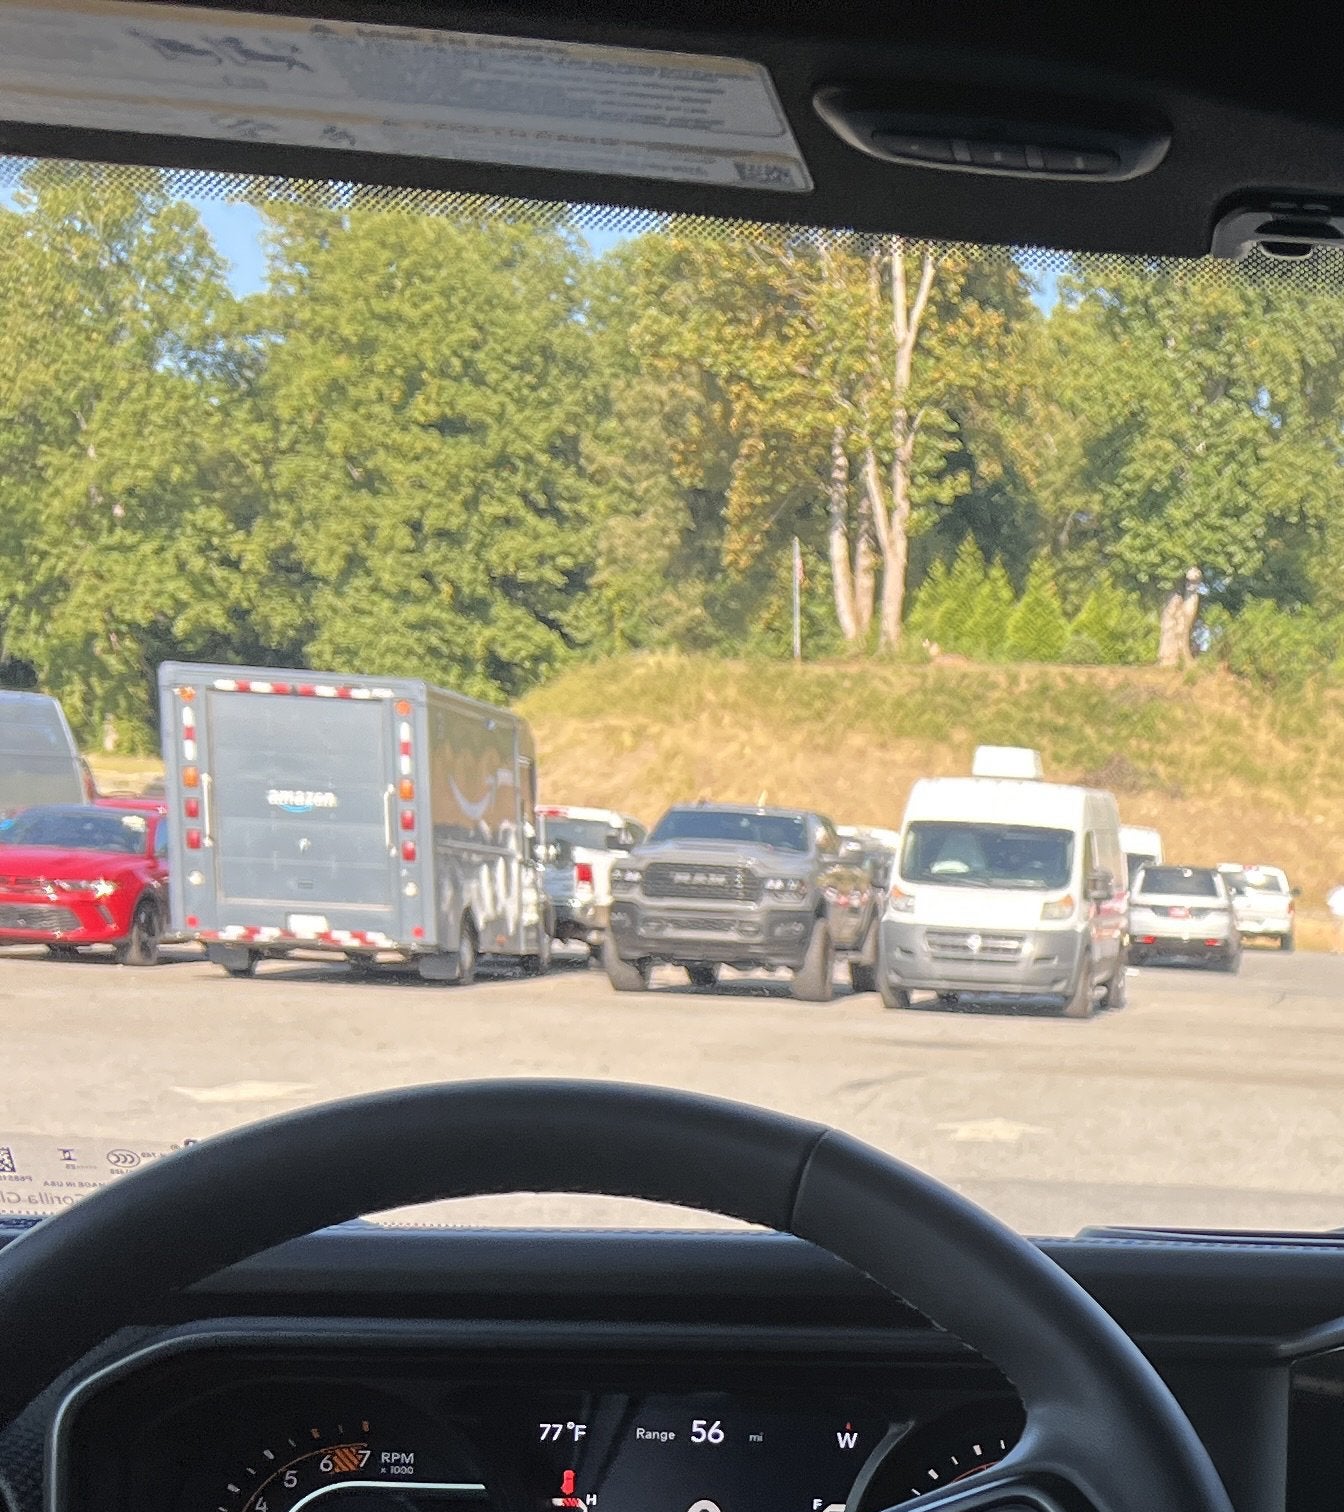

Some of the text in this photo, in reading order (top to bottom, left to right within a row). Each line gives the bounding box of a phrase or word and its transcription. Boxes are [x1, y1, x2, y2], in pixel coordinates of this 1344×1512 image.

[266, 789, 337, 808] amazon
[635, 1419, 763, 1444] Range 56 mi
[837, 1432, 858, 1449] W
[320, 1455, 334, 1472] 6
[358, 1450, 371, 1468] 7
[381, 1452, 414, 1464] RPM
[390, 1465, 414, 1475] 1000
[284, 1470, 297, 1488] 5
[586, 1495, 597, 1506] H
[813, 1498, 823, 1511] F
